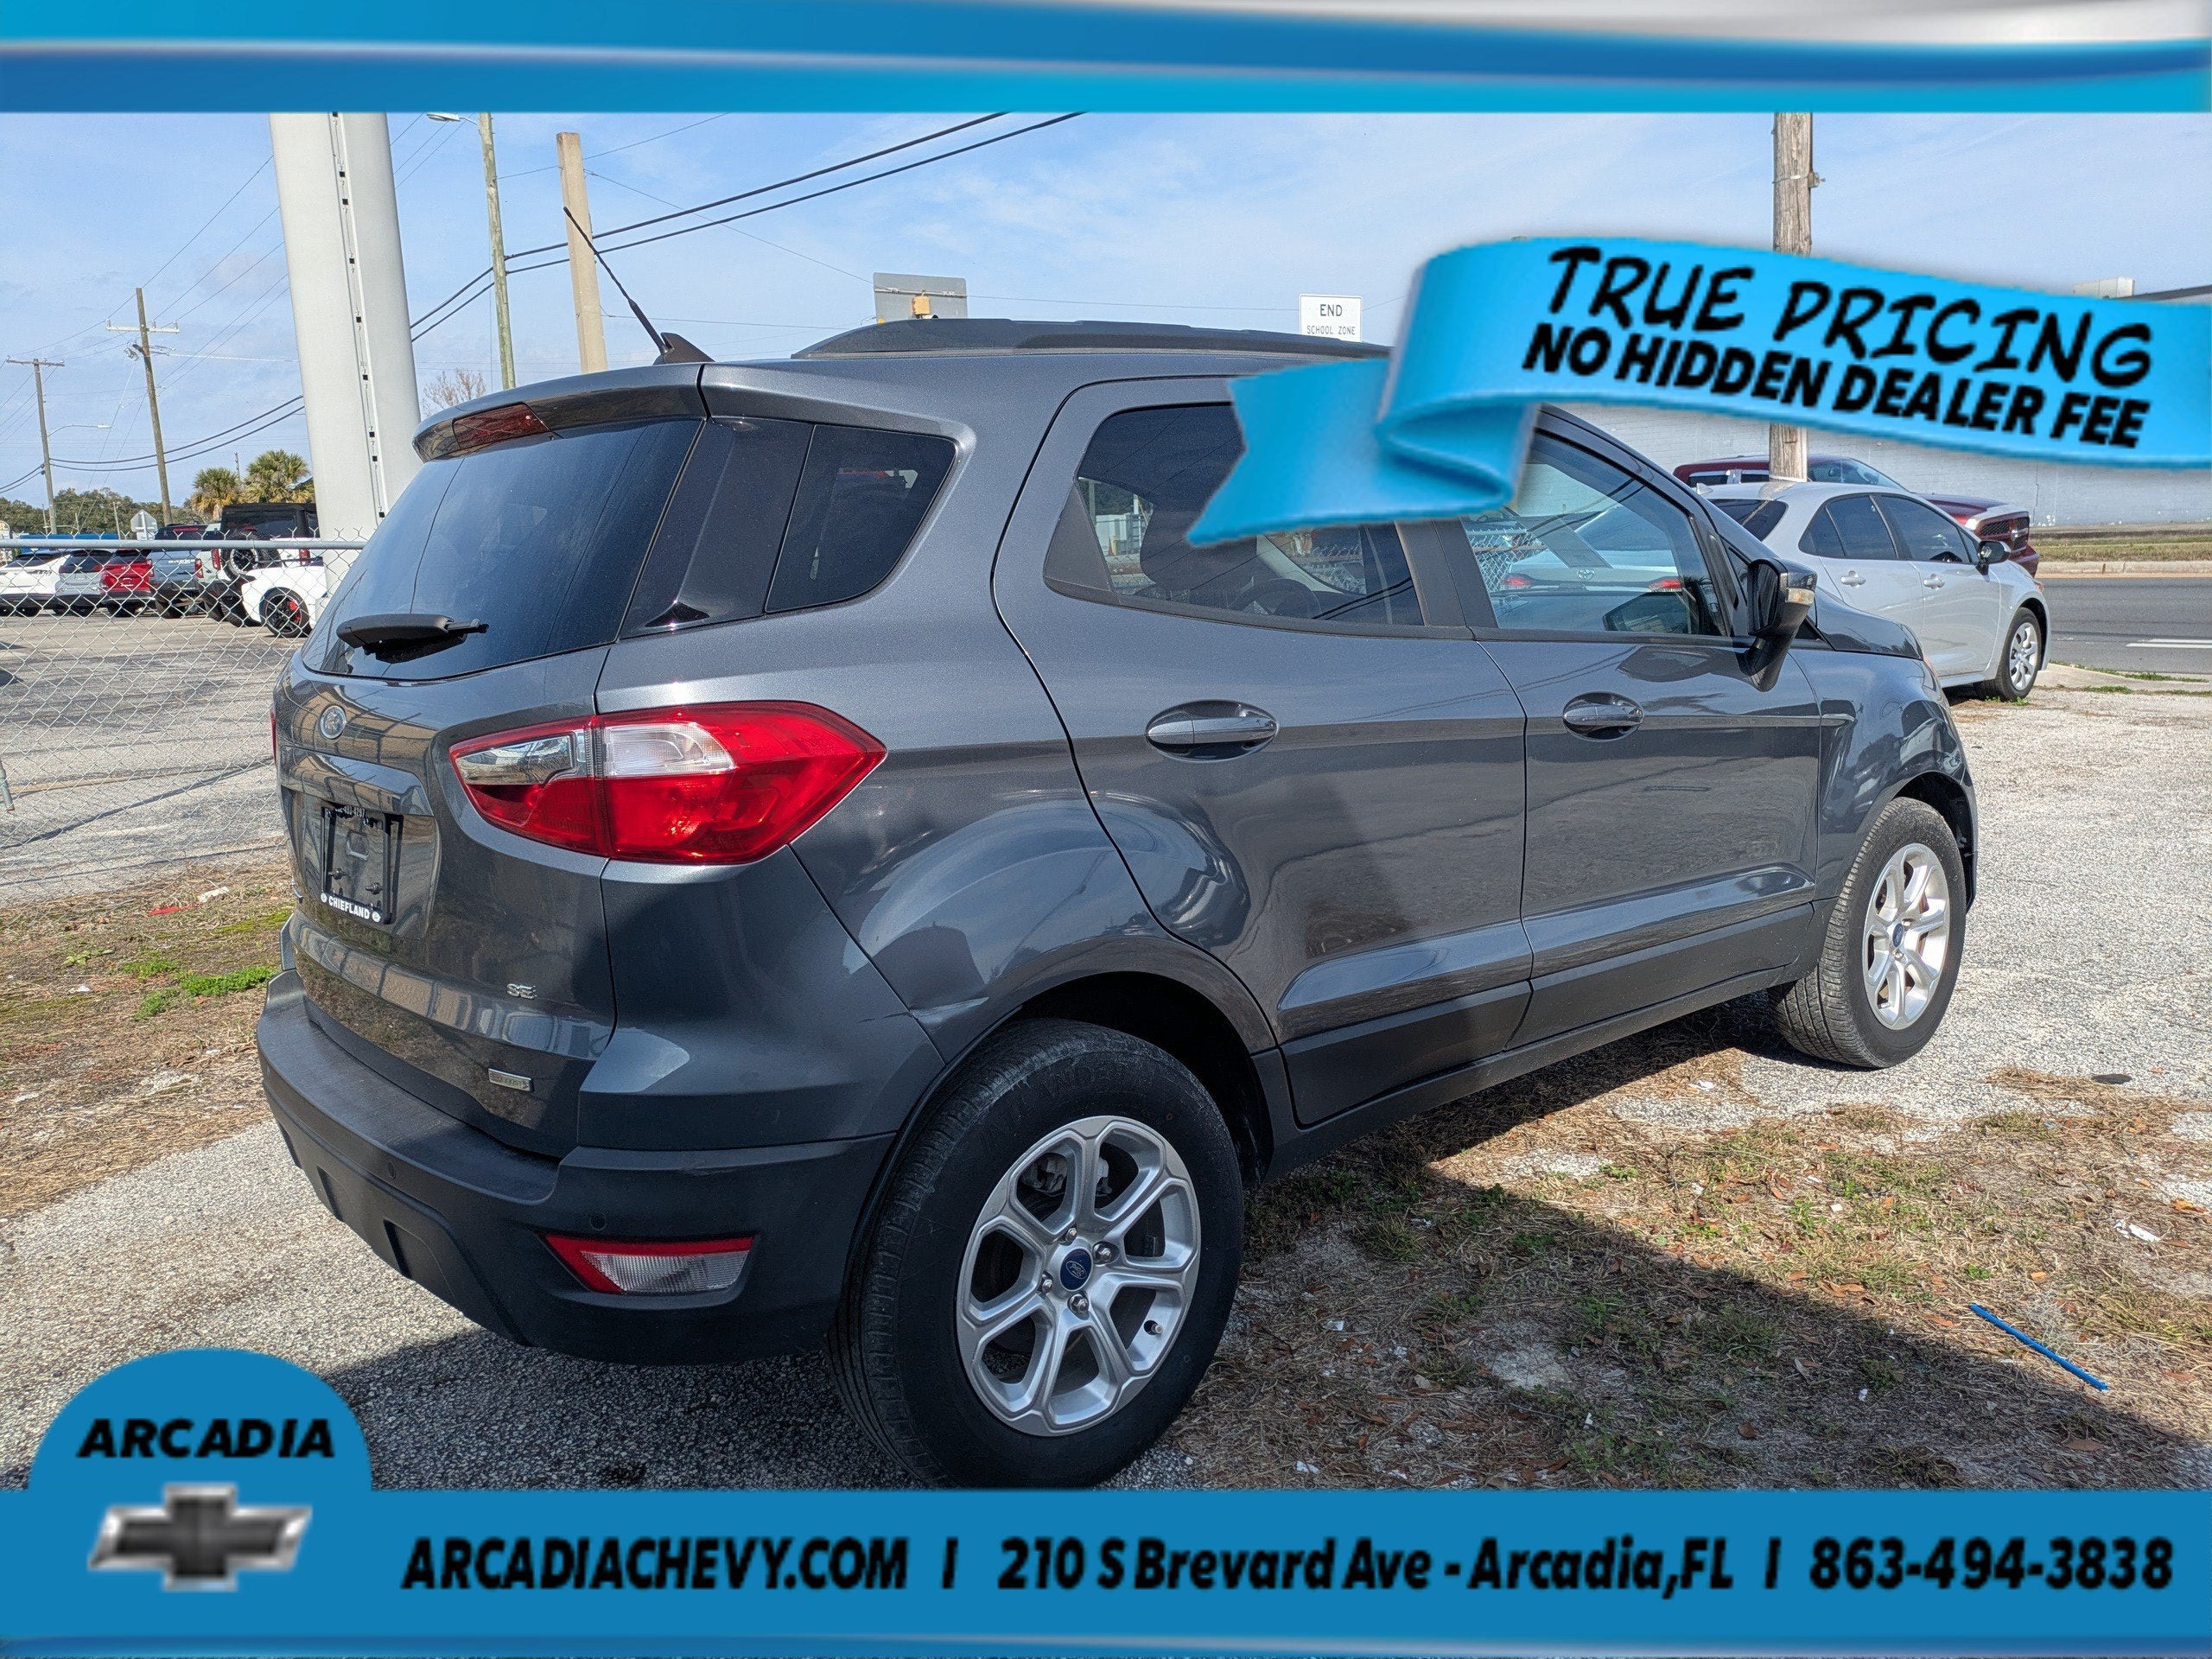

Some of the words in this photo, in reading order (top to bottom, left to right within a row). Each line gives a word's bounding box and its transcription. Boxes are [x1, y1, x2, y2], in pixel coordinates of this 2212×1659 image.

[1319, 303, 1343, 317] END
[1306, 325, 1333, 335] SCHOOL
[1338, 326, 1356, 335] ZONE
[328, 895, 371, 919] CHIEFLAND
[506, 983, 537, 1000] SE
